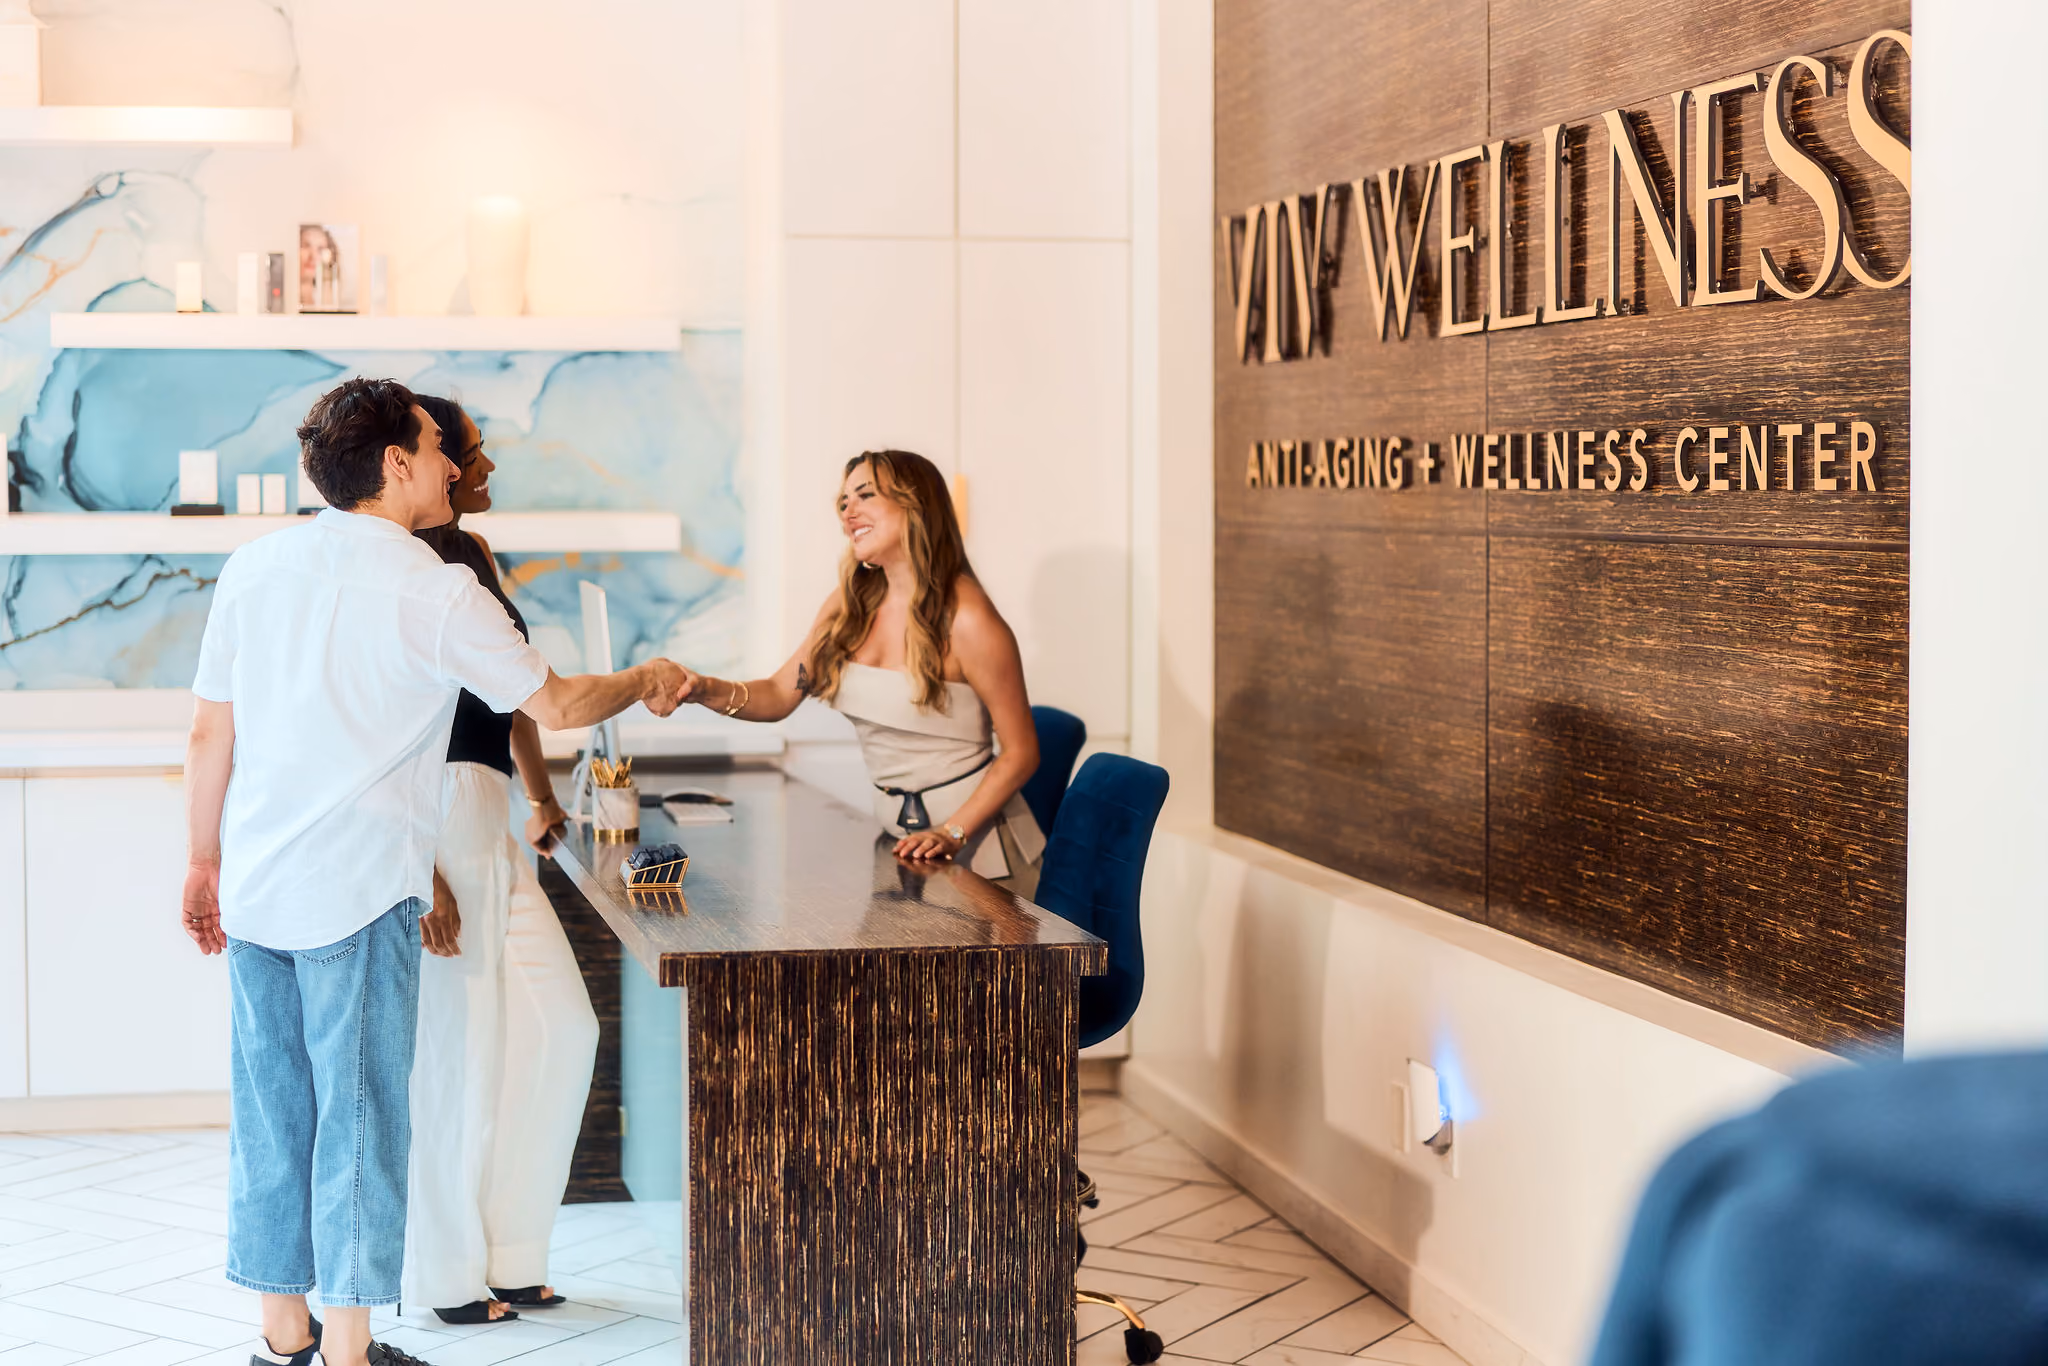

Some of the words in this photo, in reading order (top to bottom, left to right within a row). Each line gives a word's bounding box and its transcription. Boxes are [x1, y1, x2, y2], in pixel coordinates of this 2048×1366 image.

[1221, 183, 1332, 364] VIV
[1352, 30, 1911, 342] WELLNESS
[1245, 436, 1402, 489] ANTI-AGING
[1450, 429, 1648, 492] WELLNESS
[1675, 421, 1877, 492] CENTER
